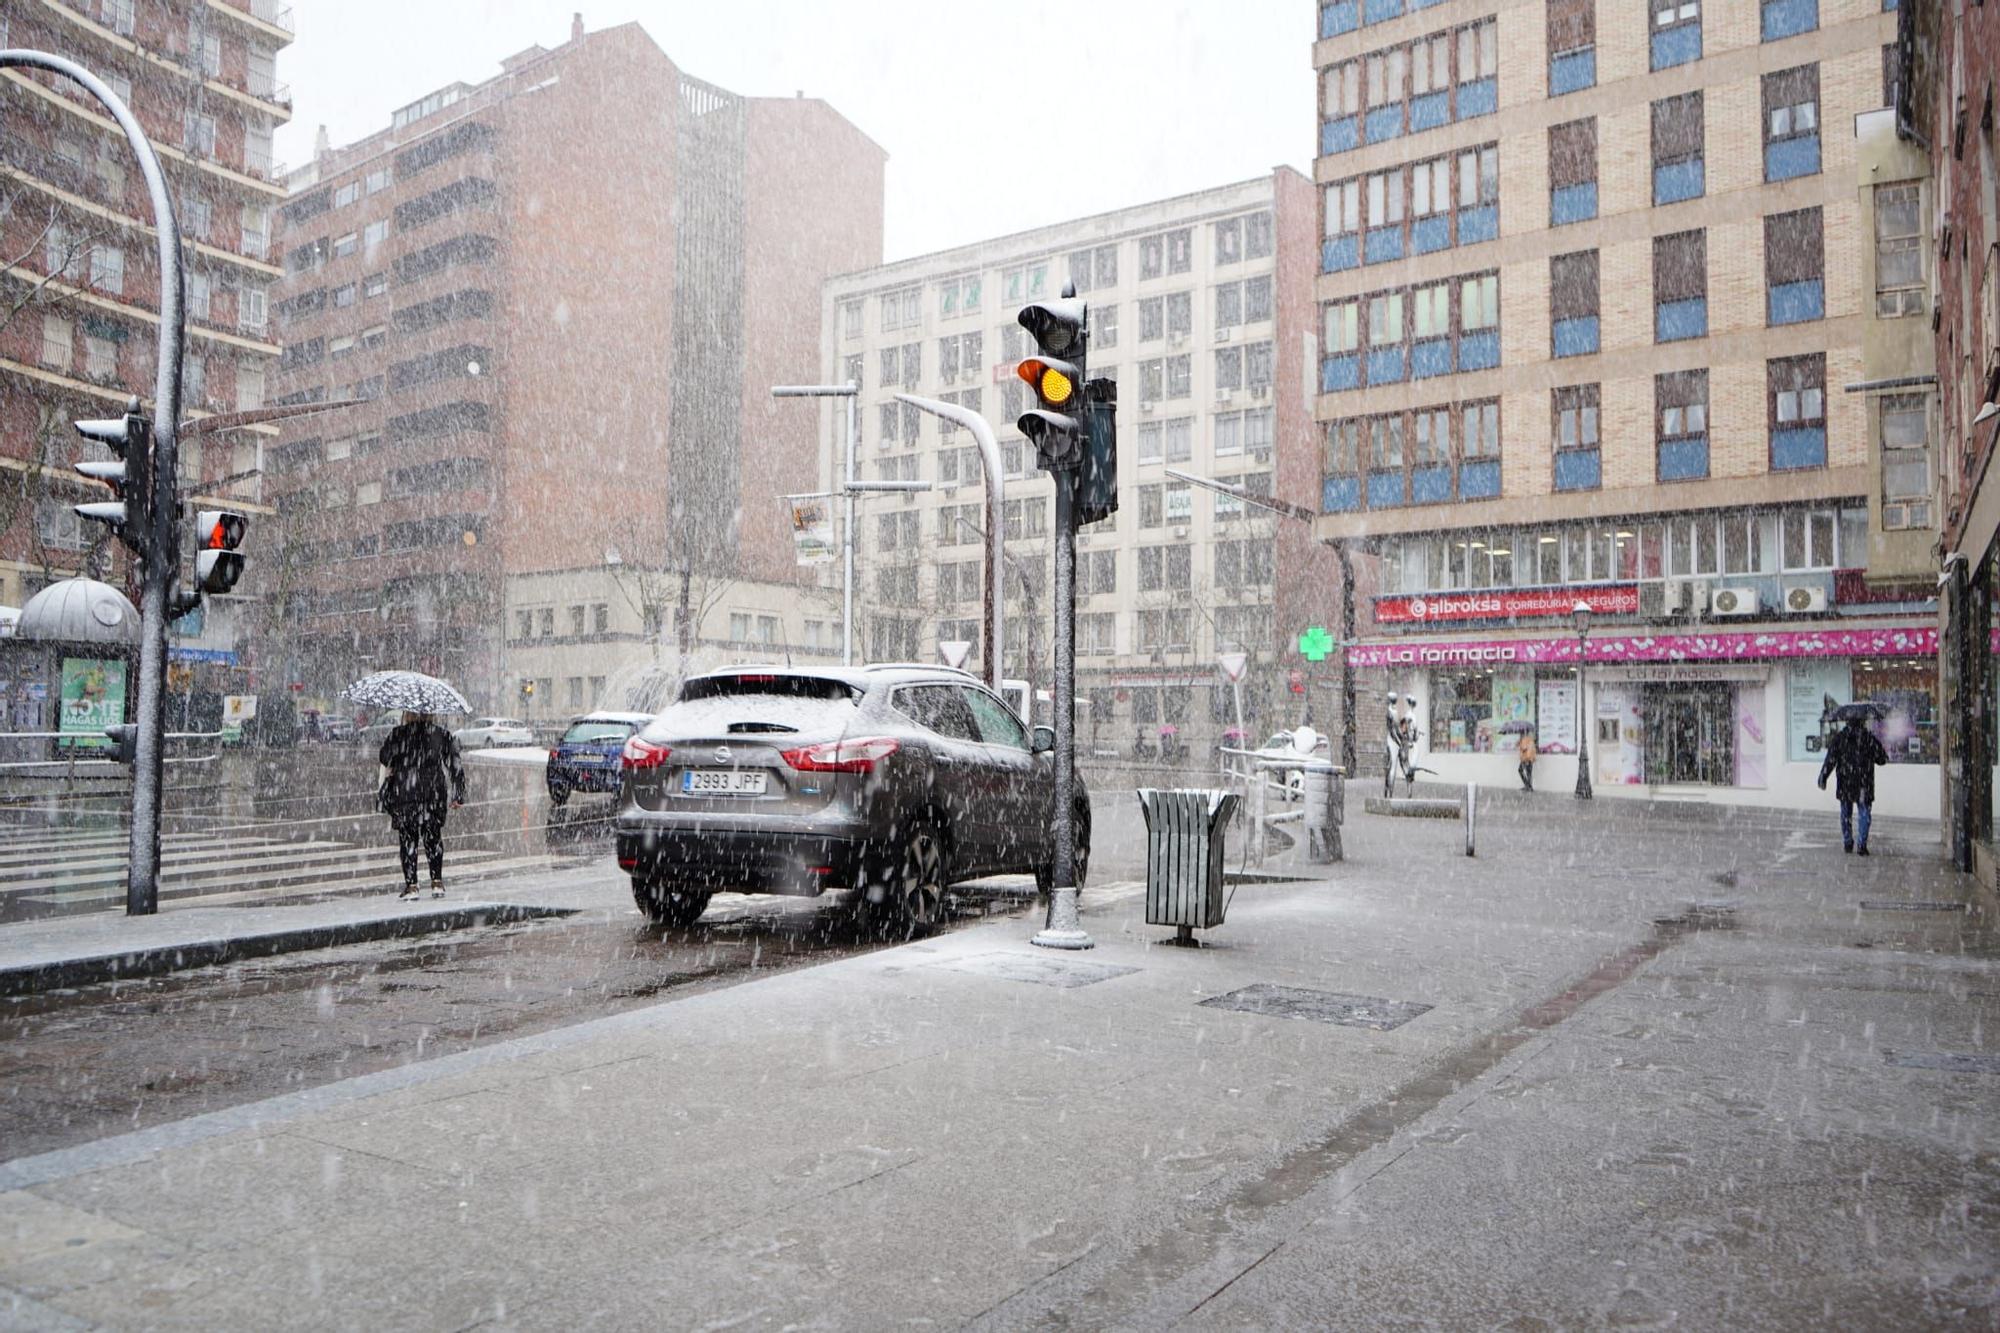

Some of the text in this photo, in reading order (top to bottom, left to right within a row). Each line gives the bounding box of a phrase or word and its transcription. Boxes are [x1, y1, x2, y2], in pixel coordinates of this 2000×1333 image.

[1428, 597, 1501, 614] albroksa
[1506, 598, 1569, 611] CORREDURIA
[1588, 594, 1637, 606] SEGUROS
[1387, 645, 1515, 662] La farmacia
[63, 715, 97, 724] HAGAS
[694, 773, 763, 790] 2993 JPF
